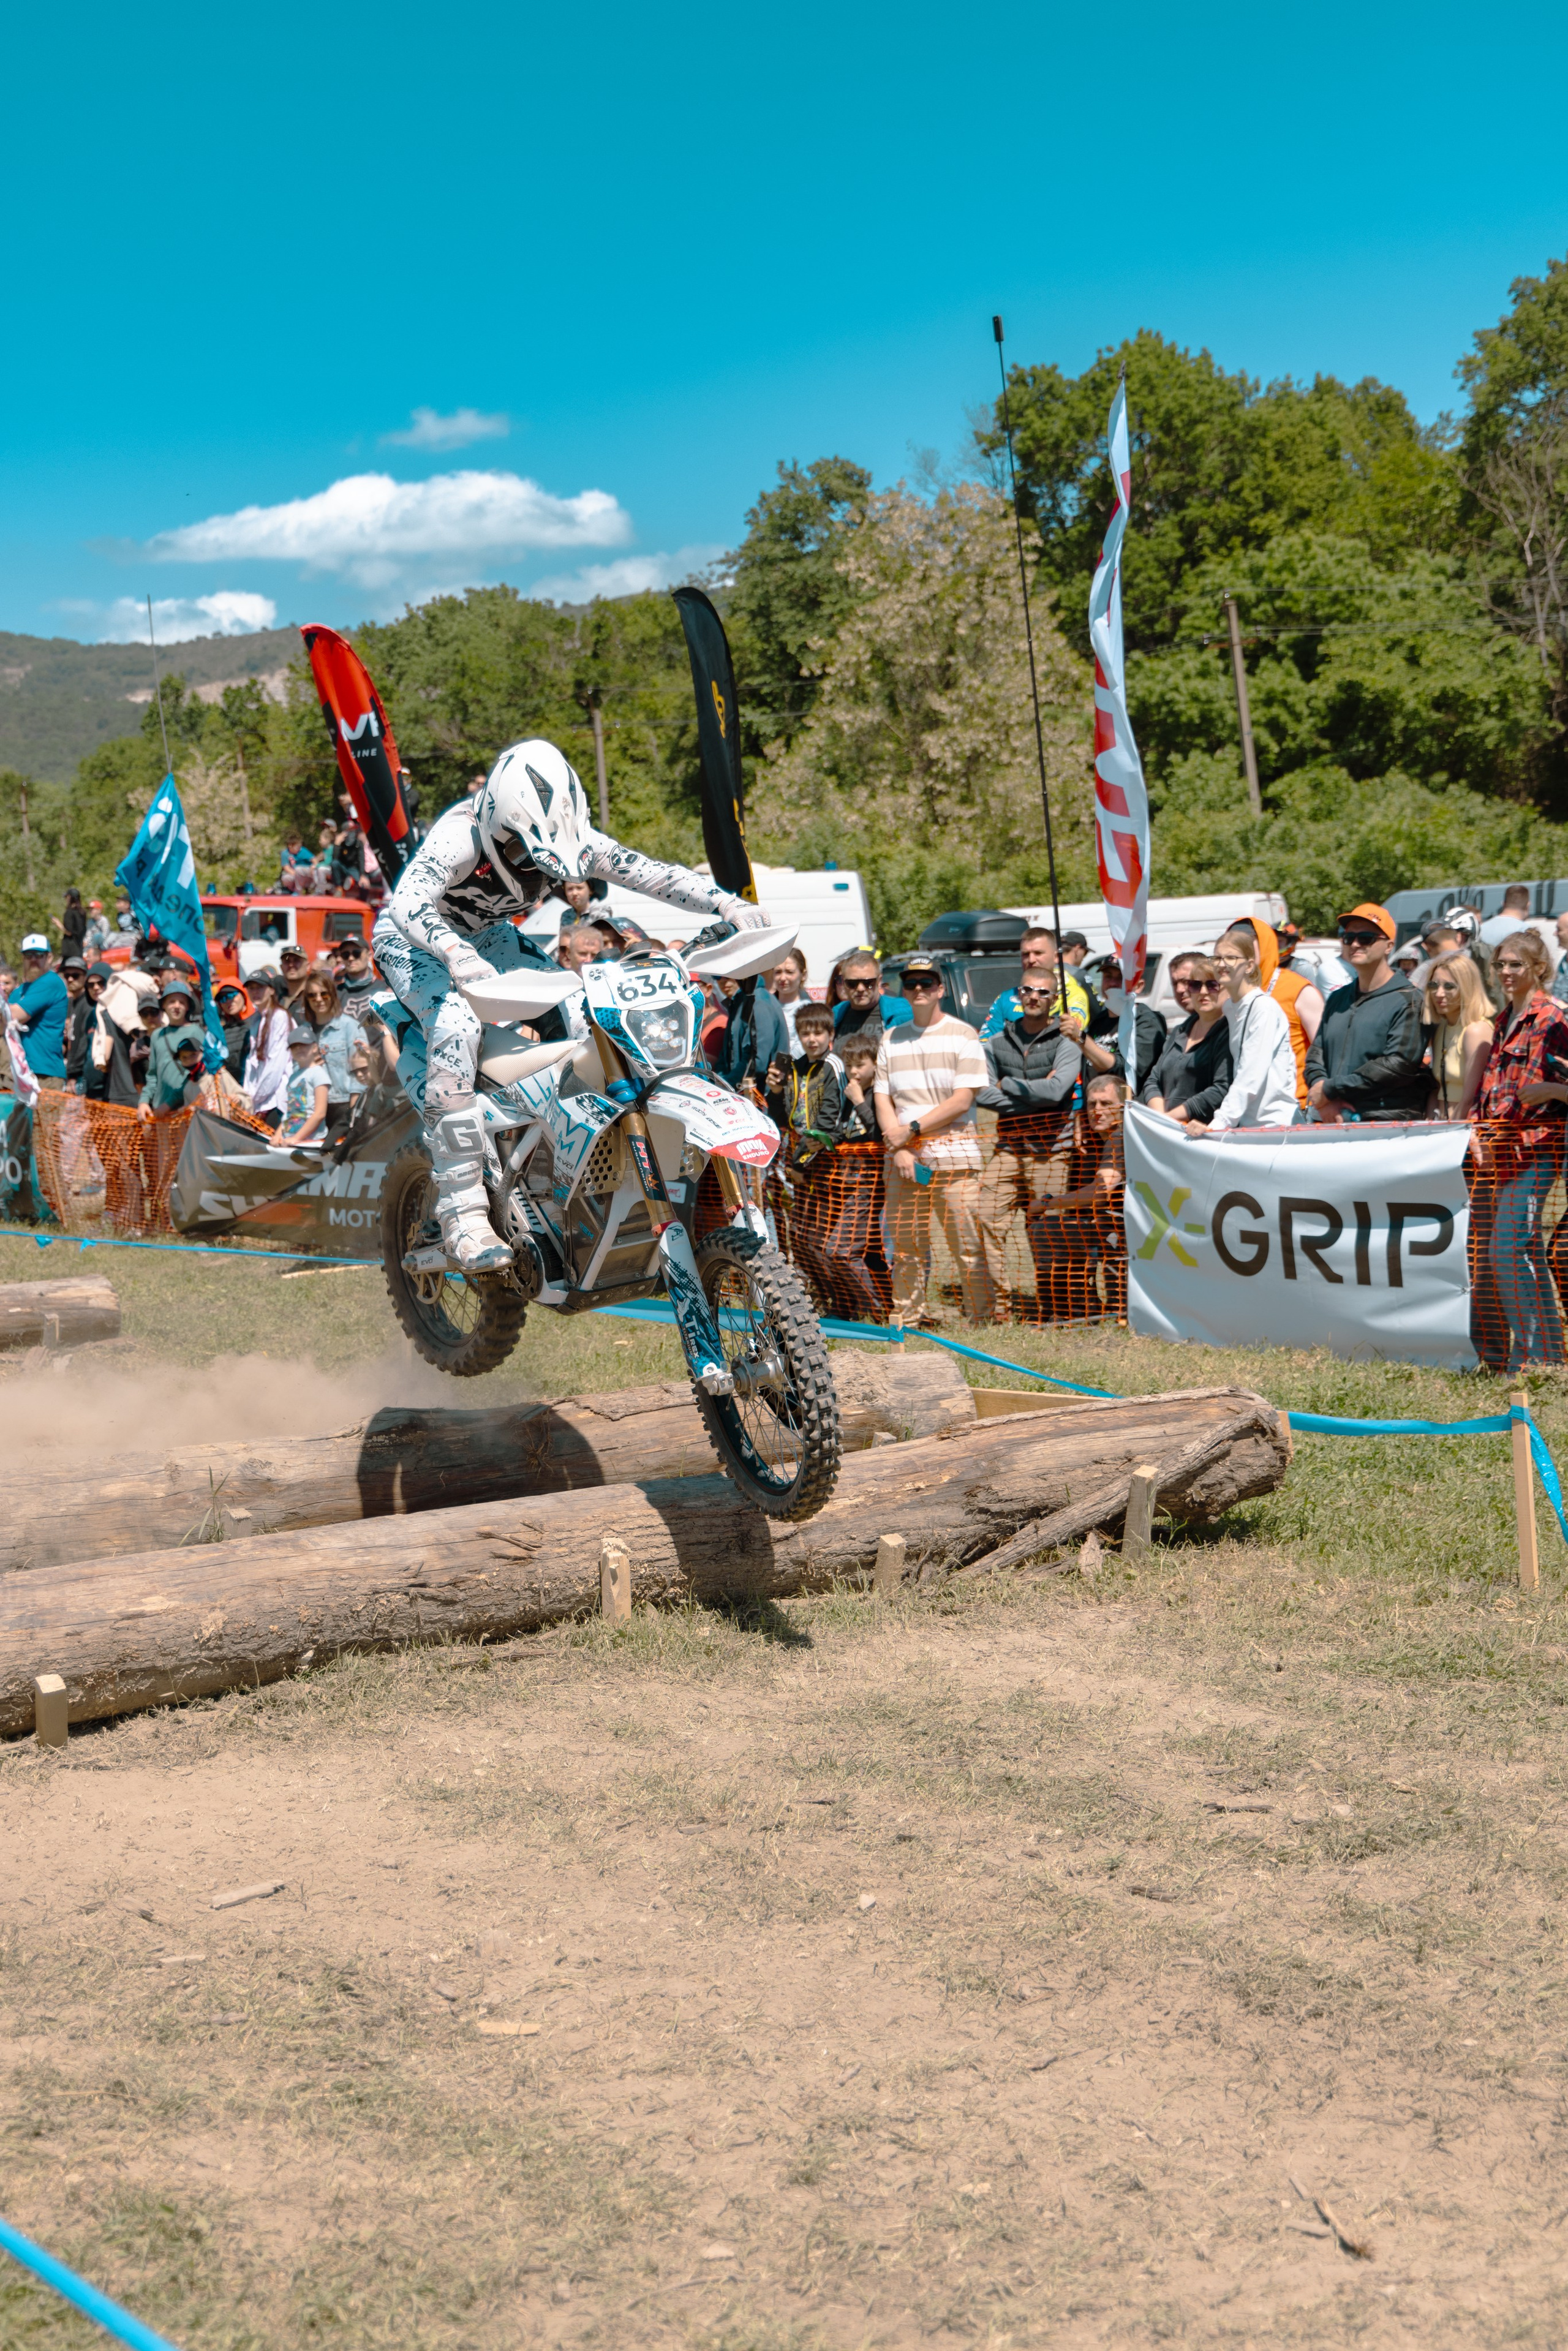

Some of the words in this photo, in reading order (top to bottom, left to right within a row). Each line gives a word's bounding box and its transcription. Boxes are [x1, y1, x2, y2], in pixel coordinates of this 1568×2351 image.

[533, 850, 567, 877] Airoh
[617, 973, 677, 1002] 634
[557, 1156, 573, 1170] EVO
[631, 1141, 649, 1192] SUSPENSION
[742, 1150, 770, 1160] ENDURO
[329, 1208, 381, 1228] MOT
